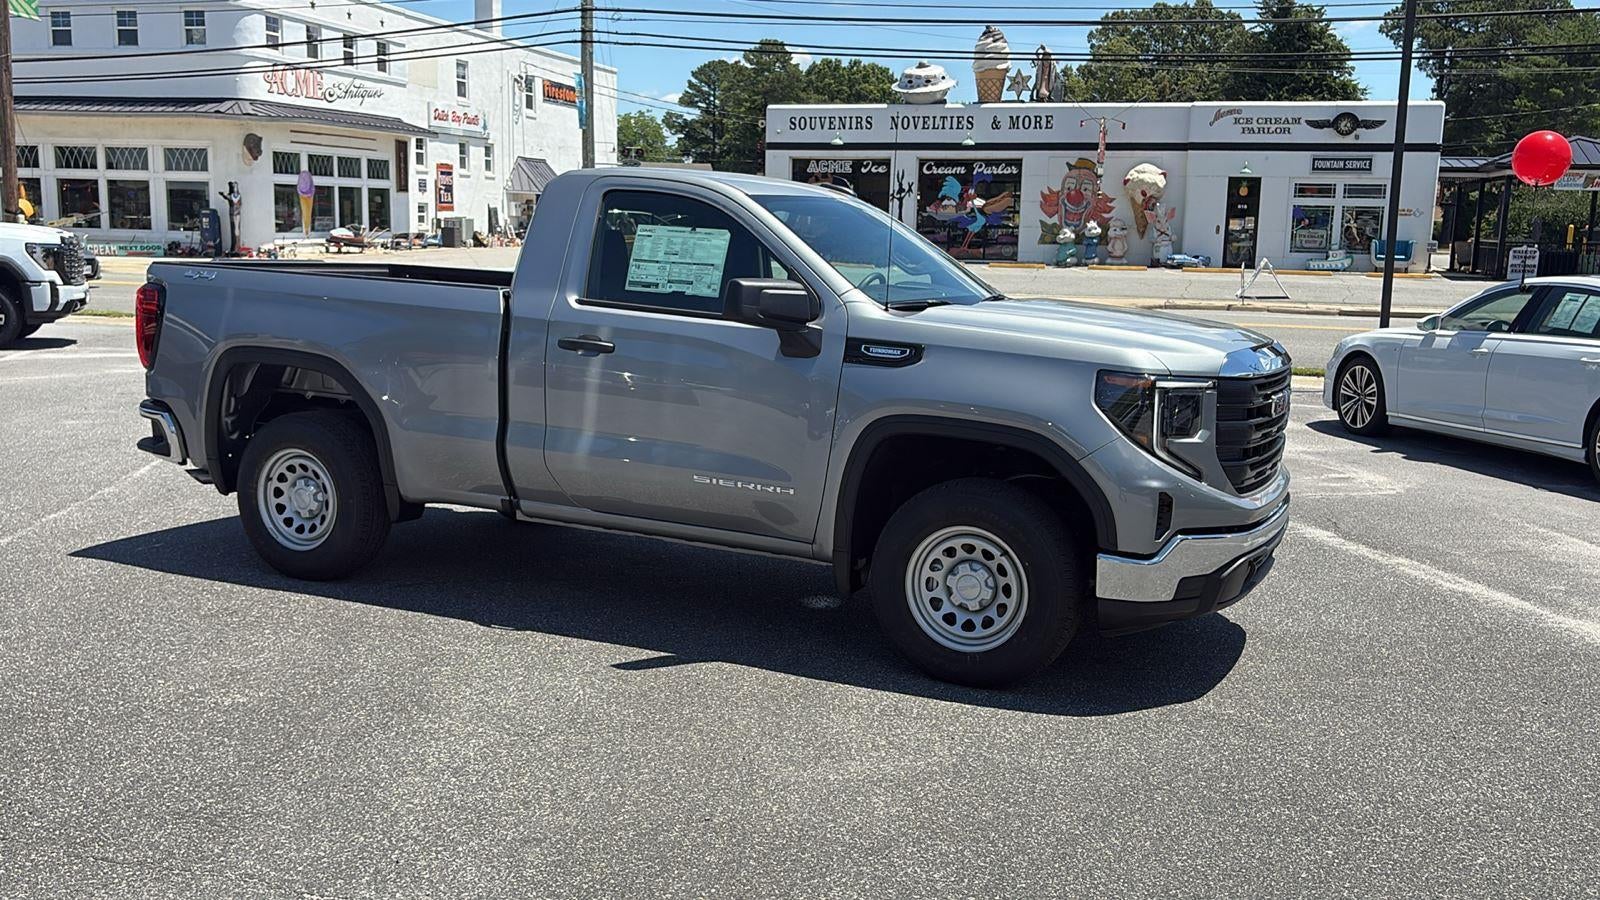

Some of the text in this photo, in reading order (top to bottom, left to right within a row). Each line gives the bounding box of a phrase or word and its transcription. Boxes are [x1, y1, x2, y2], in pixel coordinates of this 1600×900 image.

[264, 63, 384, 106] ACME Antiques
[433, 108, 480, 127] Dutch Boy Paints
[789, 115, 1054, 130] SOUVENIRS NOVELTIES & MORE
[1233, 117, 1302, 125] ICE CREAM
[1241, 127, 1292, 135] PARLOR
[807, 160, 1019, 175] ACME Ice Cream Parlor
[1314, 160, 1370, 169] FOUNTAIN SERVICE
[440, 190, 453, 202] TEA
[87, 243, 118, 256] CREAM
[693, 474, 795, 495] SIERRA
